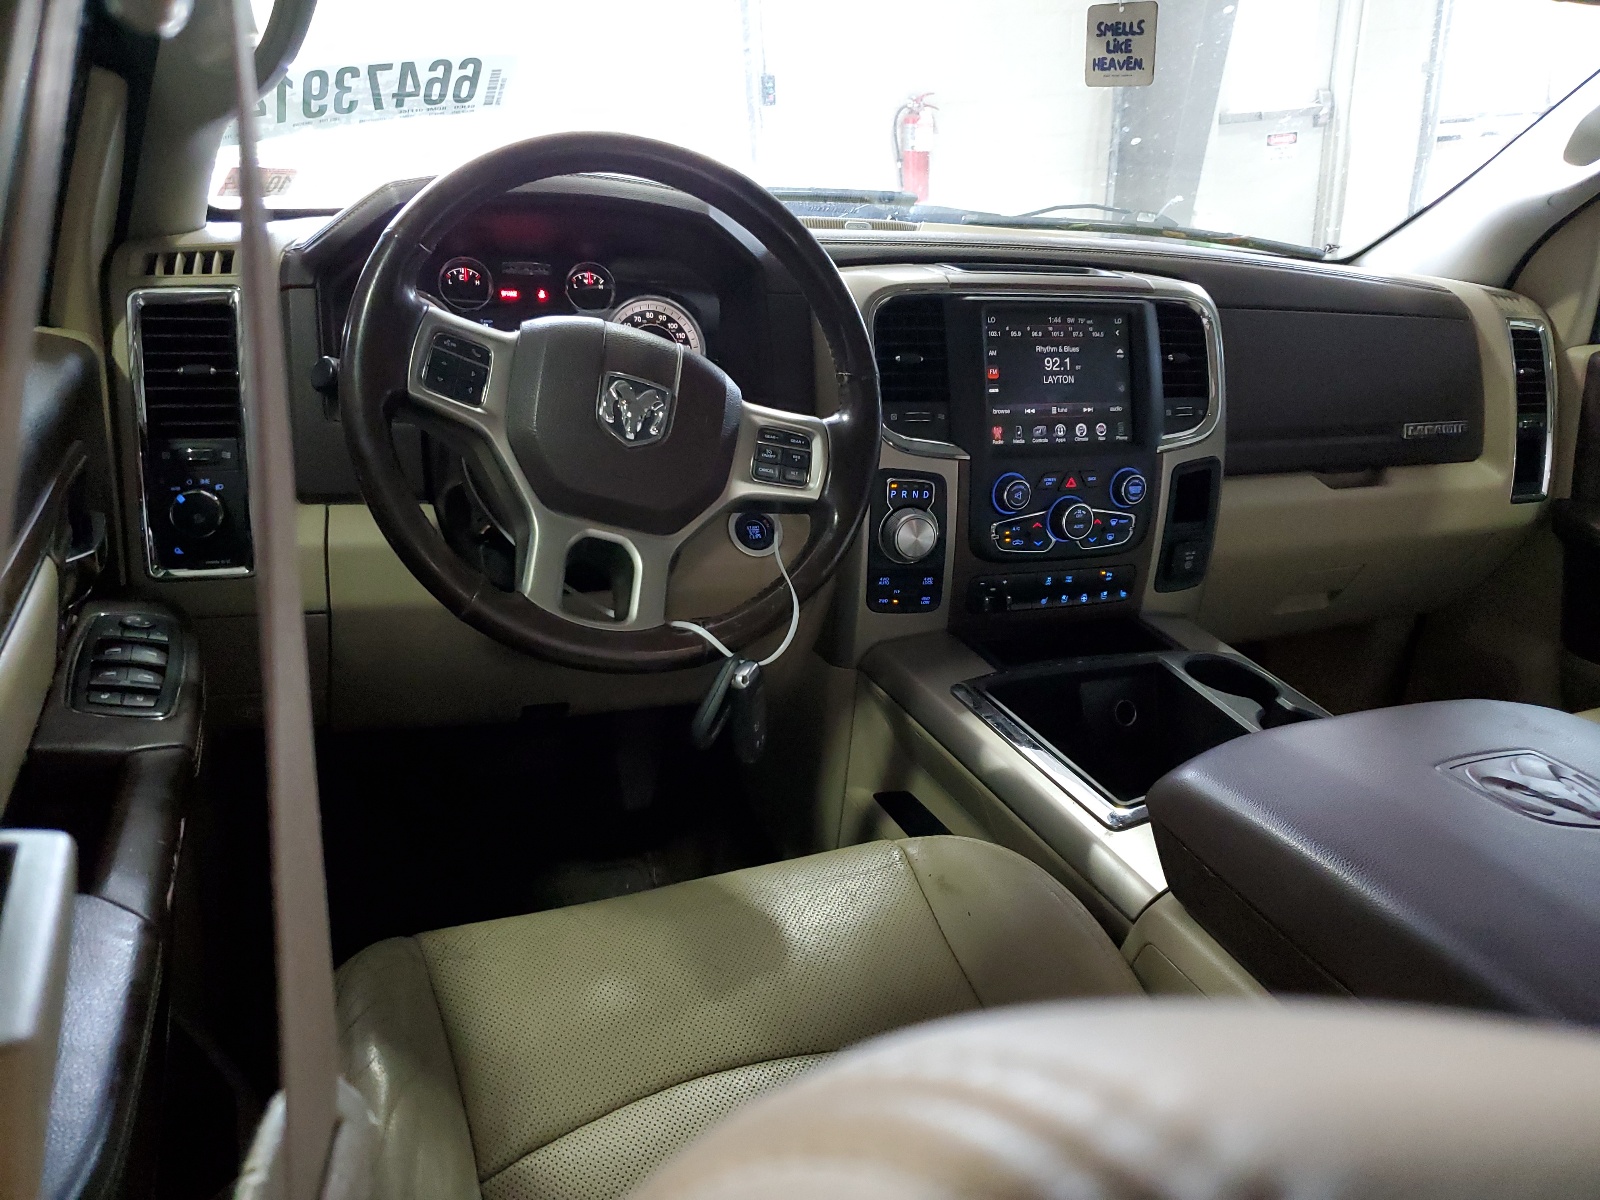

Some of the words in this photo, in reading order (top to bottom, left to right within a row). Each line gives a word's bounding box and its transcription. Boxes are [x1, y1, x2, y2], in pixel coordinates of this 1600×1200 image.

[1096, 19, 1145, 37] SMELLS
[1044, 357, 1070, 371] 92.1
[1043, 375, 1075, 384] LAYTON
